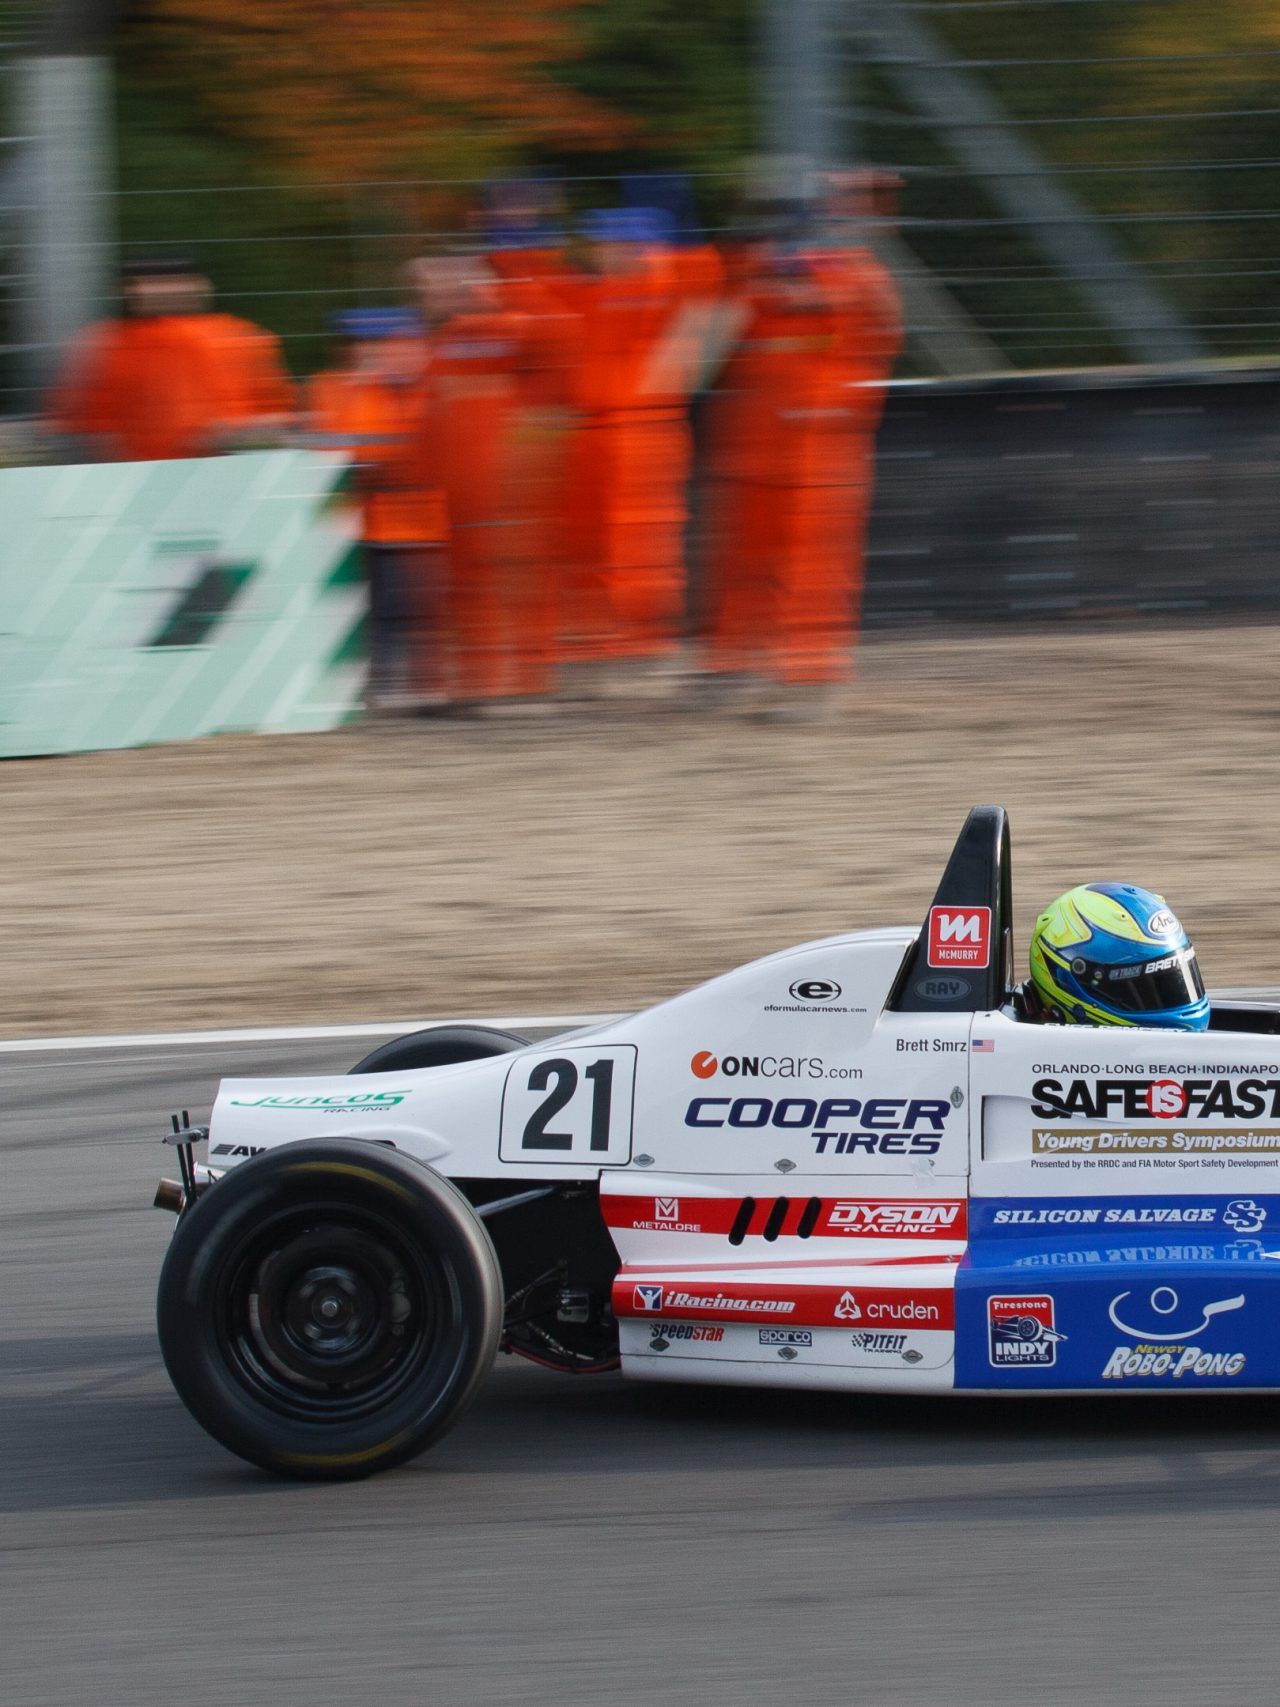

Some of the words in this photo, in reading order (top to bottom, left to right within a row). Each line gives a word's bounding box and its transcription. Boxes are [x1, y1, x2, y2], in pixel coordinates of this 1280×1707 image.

[925, 982, 960, 995] RAY
[764, 1003, 868, 1014] eformulacarnews.com
[895, 1038, 929, 1053] Brett
[931, 1038, 968, 1053] Smrz
[721, 1054, 863, 1080] ONcars.com
[521, 1058, 614, 1152] 21
[1030, 1079, 1149, 1119] SAFE
[1150, 1085, 1184, 1114] IS
[322, 1106, 391, 1114] RACING
[684, 1097, 951, 1130] COOPER
[811, 1132, 944, 1155] TIRES
[1036, 1134, 1094, 1150] Young
[1100, 1133, 1168, 1148] Drivers
[1031, 1159, 1070, 1169] Presented
[1071, 1159, 1082, 1170] by
[1083, 1159, 1096, 1169] the
[1097, 1159, 1120, 1169] RRDC
[1121, 1159, 1137, 1169] and
[1138, 1159, 1151, 1169] FIA
[1153, 1159, 1176, 1169] Motor
[1178, 1159, 1199, 1170] Sport
[1201, 1159, 1226, 1170] Safety
[1227, 1159, 1279, 1170] Development
[829, 1205, 959, 1225] DYSON
[993, 1209, 1102, 1224] SILICON
[1104, 1208, 1217, 1223] SALVAGE
[633, 1221, 701, 1232] METALORE
[843, 1224, 937, 1233] RACING
[664, 1293, 796, 1313] iRacing.com
[866, 1300, 939, 1320] cruden
[993, 1300, 1048, 1310] Firestone
[761, 1331, 811, 1344] sparco
[864, 1333, 908, 1349] PITFIT
[995, 1341, 1051, 1355] INDY
[995, 1354, 1050, 1363] LIGHTS
